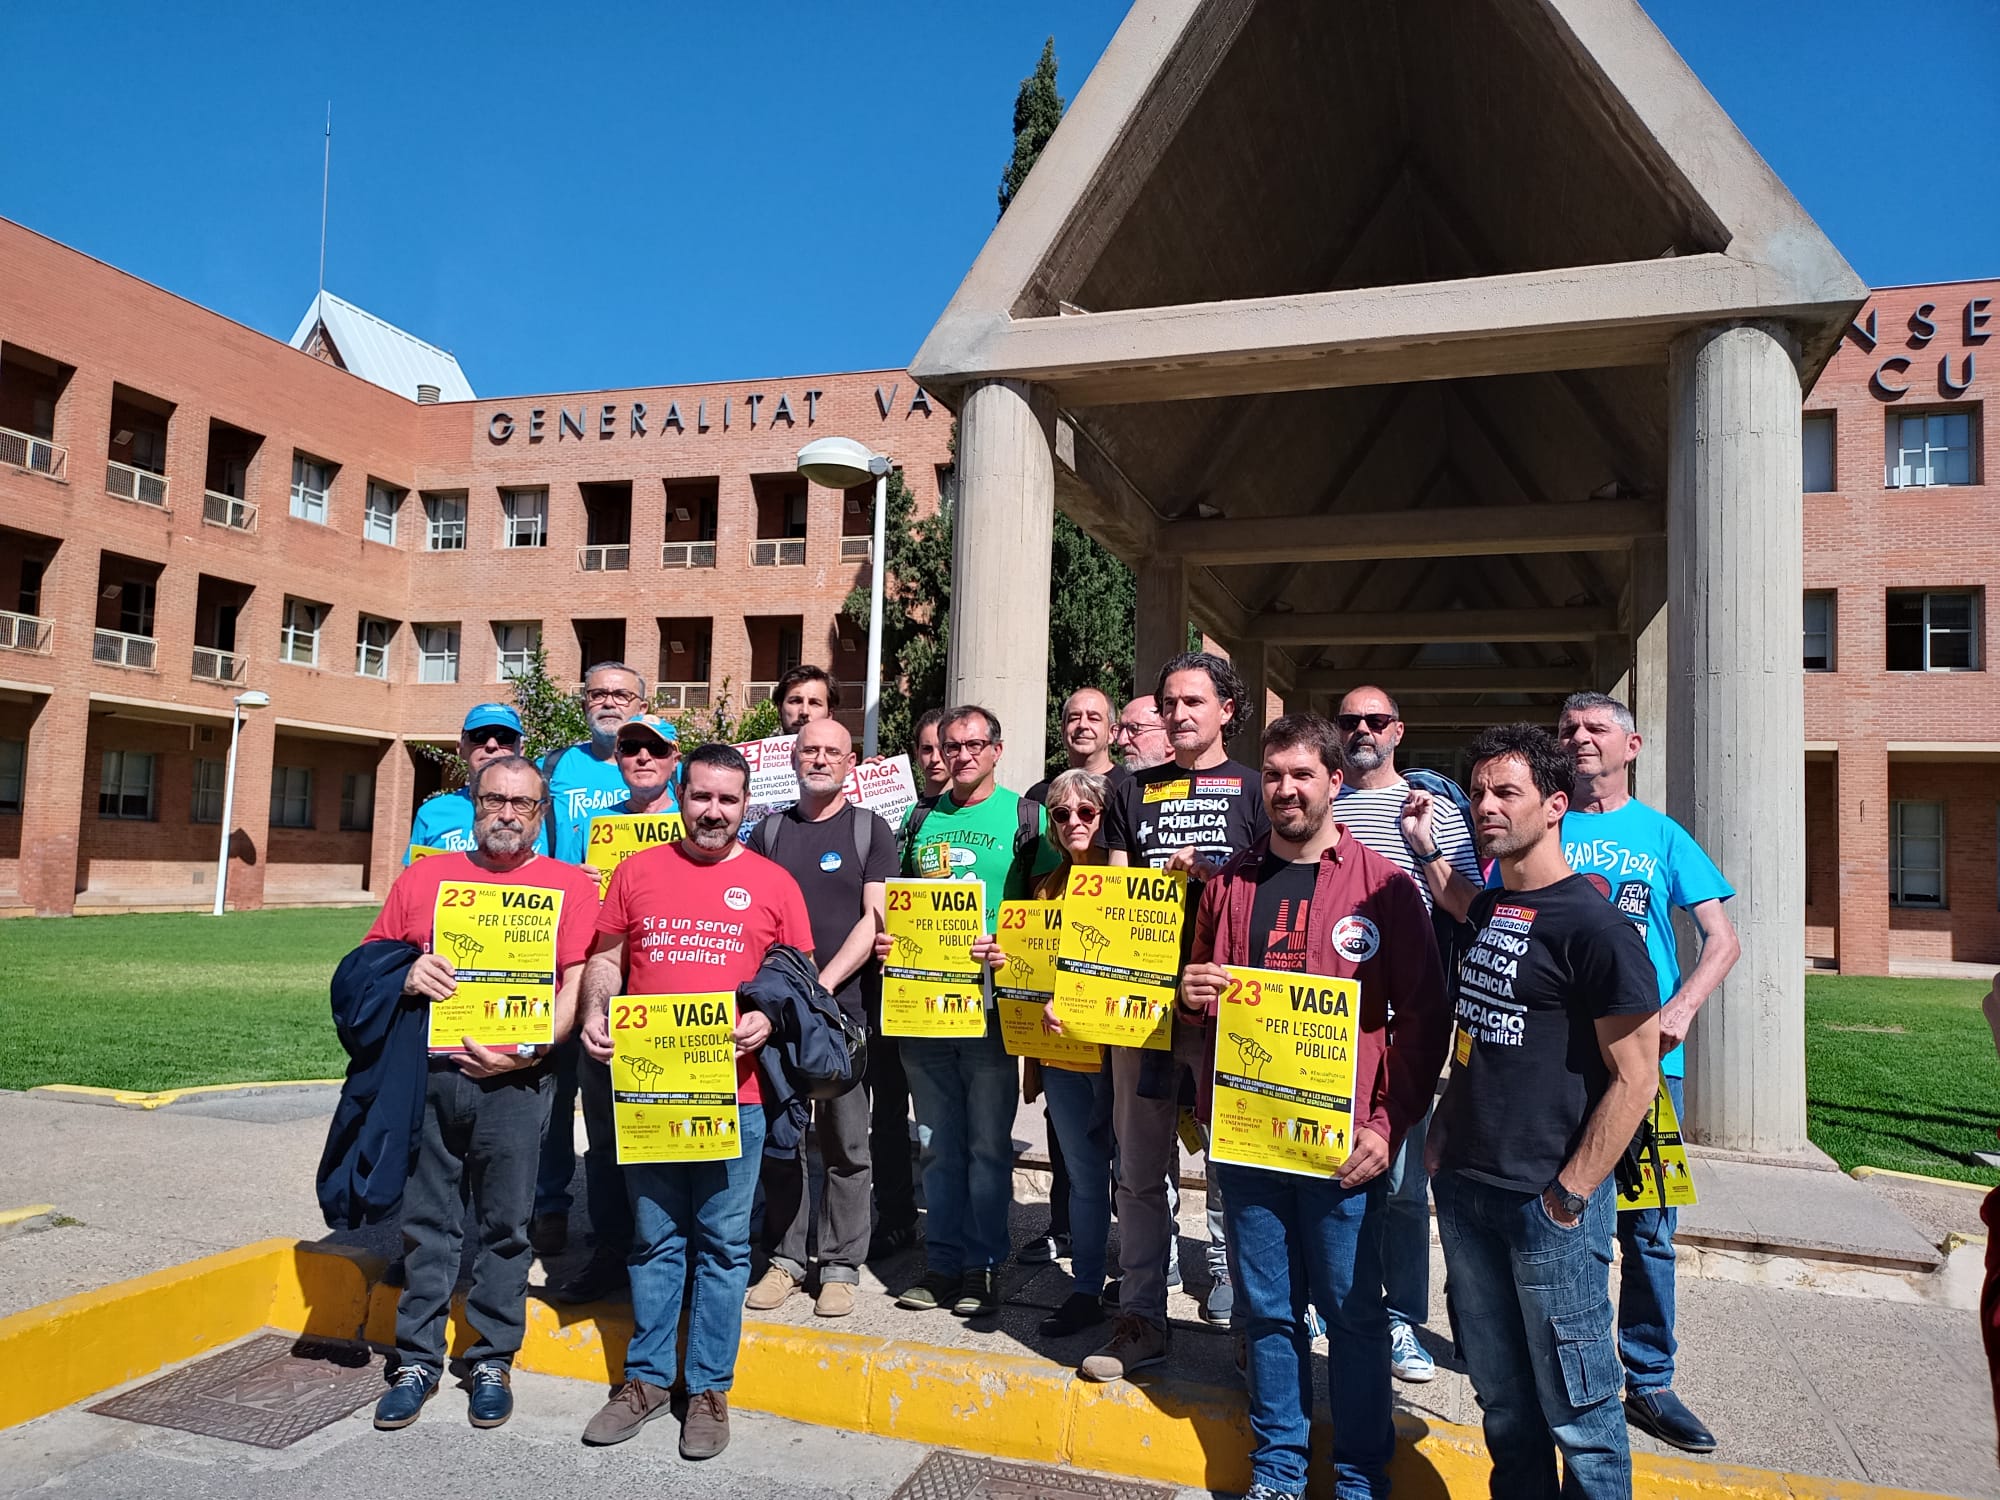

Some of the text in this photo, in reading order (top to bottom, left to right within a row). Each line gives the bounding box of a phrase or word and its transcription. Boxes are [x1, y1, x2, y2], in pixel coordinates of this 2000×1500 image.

[489, 389, 823, 442] GENERALITAT
[859, 764, 899, 781] VAGA
[863, 778, 895, 790] GENERAL
[864, 784, 905, 798] EDUCATIVA
[1160, 797, 1229, 813] INVERSIÓ
[1158, 813, 1227, 829] PÚBLICA
[591, 824, 613, 844] 23
[634, 822, 684, 842] VAGA
[926, 830, 997, 850] ESTIMEM
[1158, 828, 1226, 845] VALENCIÀ
[921, 861, 940, 870] VAGA
[922, 854, 938, 862] FAIG
[728, 889, 747, 902] UGT
[1072, 874, 1178, 903] 23 MAIG VAGA
[1622, 884, 1649, 899] FEM
[442, 889, 476, 907] 23
[502, 892, 553, 911] VAGA
[889, 890, 911, 911] 23
[931, 891, 977, 911] VAGA
[1002, 908, 1026, 929] 23
[1028, 909, 1040, 917] MAIG
[1105, 906, 1177, 925] PER L'ESCOLA
[1496, 907, 1521, 917] CCOO
[478, 915, 551, 926] PER L'ESCOLA
[643, 916, 743, 936] Sí a un servei
[917, 919, 978, 930] PER L'ESCOLA
[1491, 918, 1529, 931] educació
[505, 927, 549, 943] PÚBLICA
[939, 933, 978, 946] PÚBLICA
[1131, 924, 1175, 943] PÚBLICA
[641, 932, 745, 953] públic educatiu
[1028, 938, 1043, 950] PER
[1346, 939, 1366, 949] CGT
[650, 949, 726, 966] de qualitat
[1264, 952, 1306, 960] ANARCO
[1264, 960, 1303, 968] SINDICA
[1462, 965, 1515, 999] VALENCIÀ
[1227, 978, 1349, 1017] 23 MAIG VAGA
[615, 1002, 728, 1029] 23 MAIG VAGA
[1266, 1018, 1348, 1041] PER L'ESCOLA
[1481, 1028, 1524, 1046] qualitat
[655, 1033, 730, 1048] PER L'ESCOLA
[684, 1048, 730, 1064] PÚBLICA
[1296, 1039, 1347, 1061] PÚBLICA
